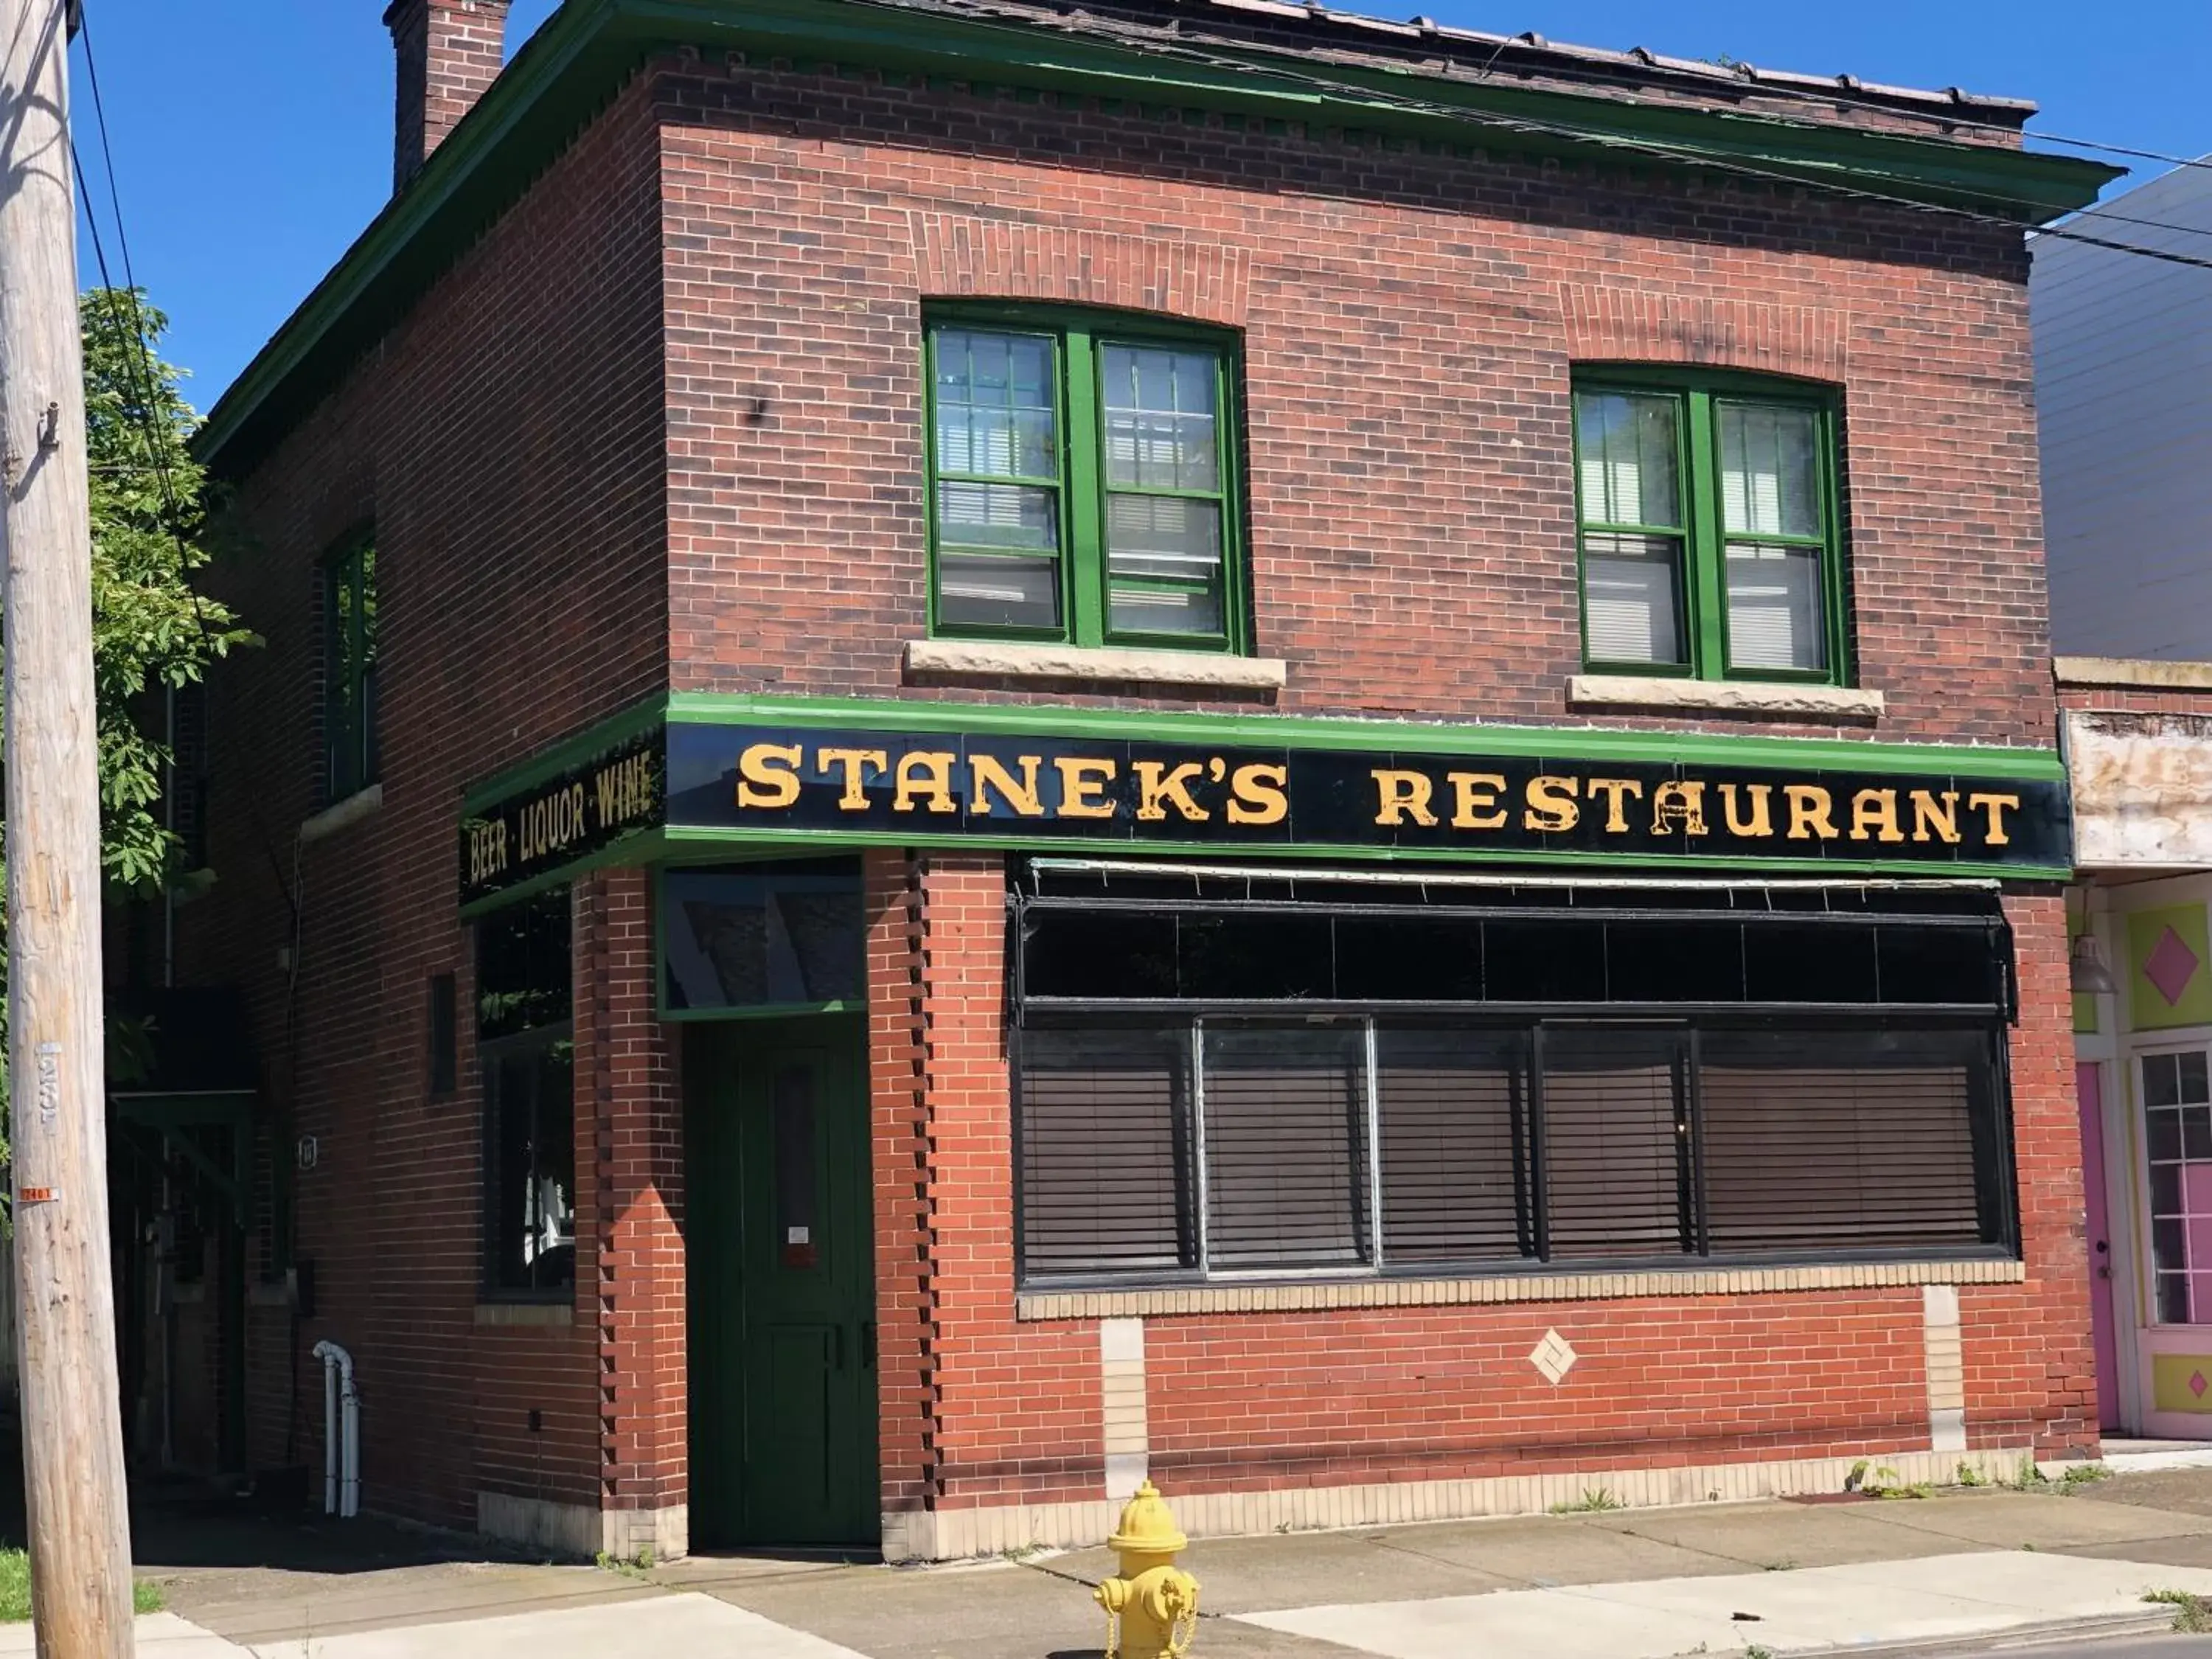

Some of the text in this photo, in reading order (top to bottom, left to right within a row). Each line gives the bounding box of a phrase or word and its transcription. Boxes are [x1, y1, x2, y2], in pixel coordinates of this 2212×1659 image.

[470, 749, 652, 885] BEER LIQUOR WINE
[737, 744, 2020, 845] STANEK'S RESTAURANT
